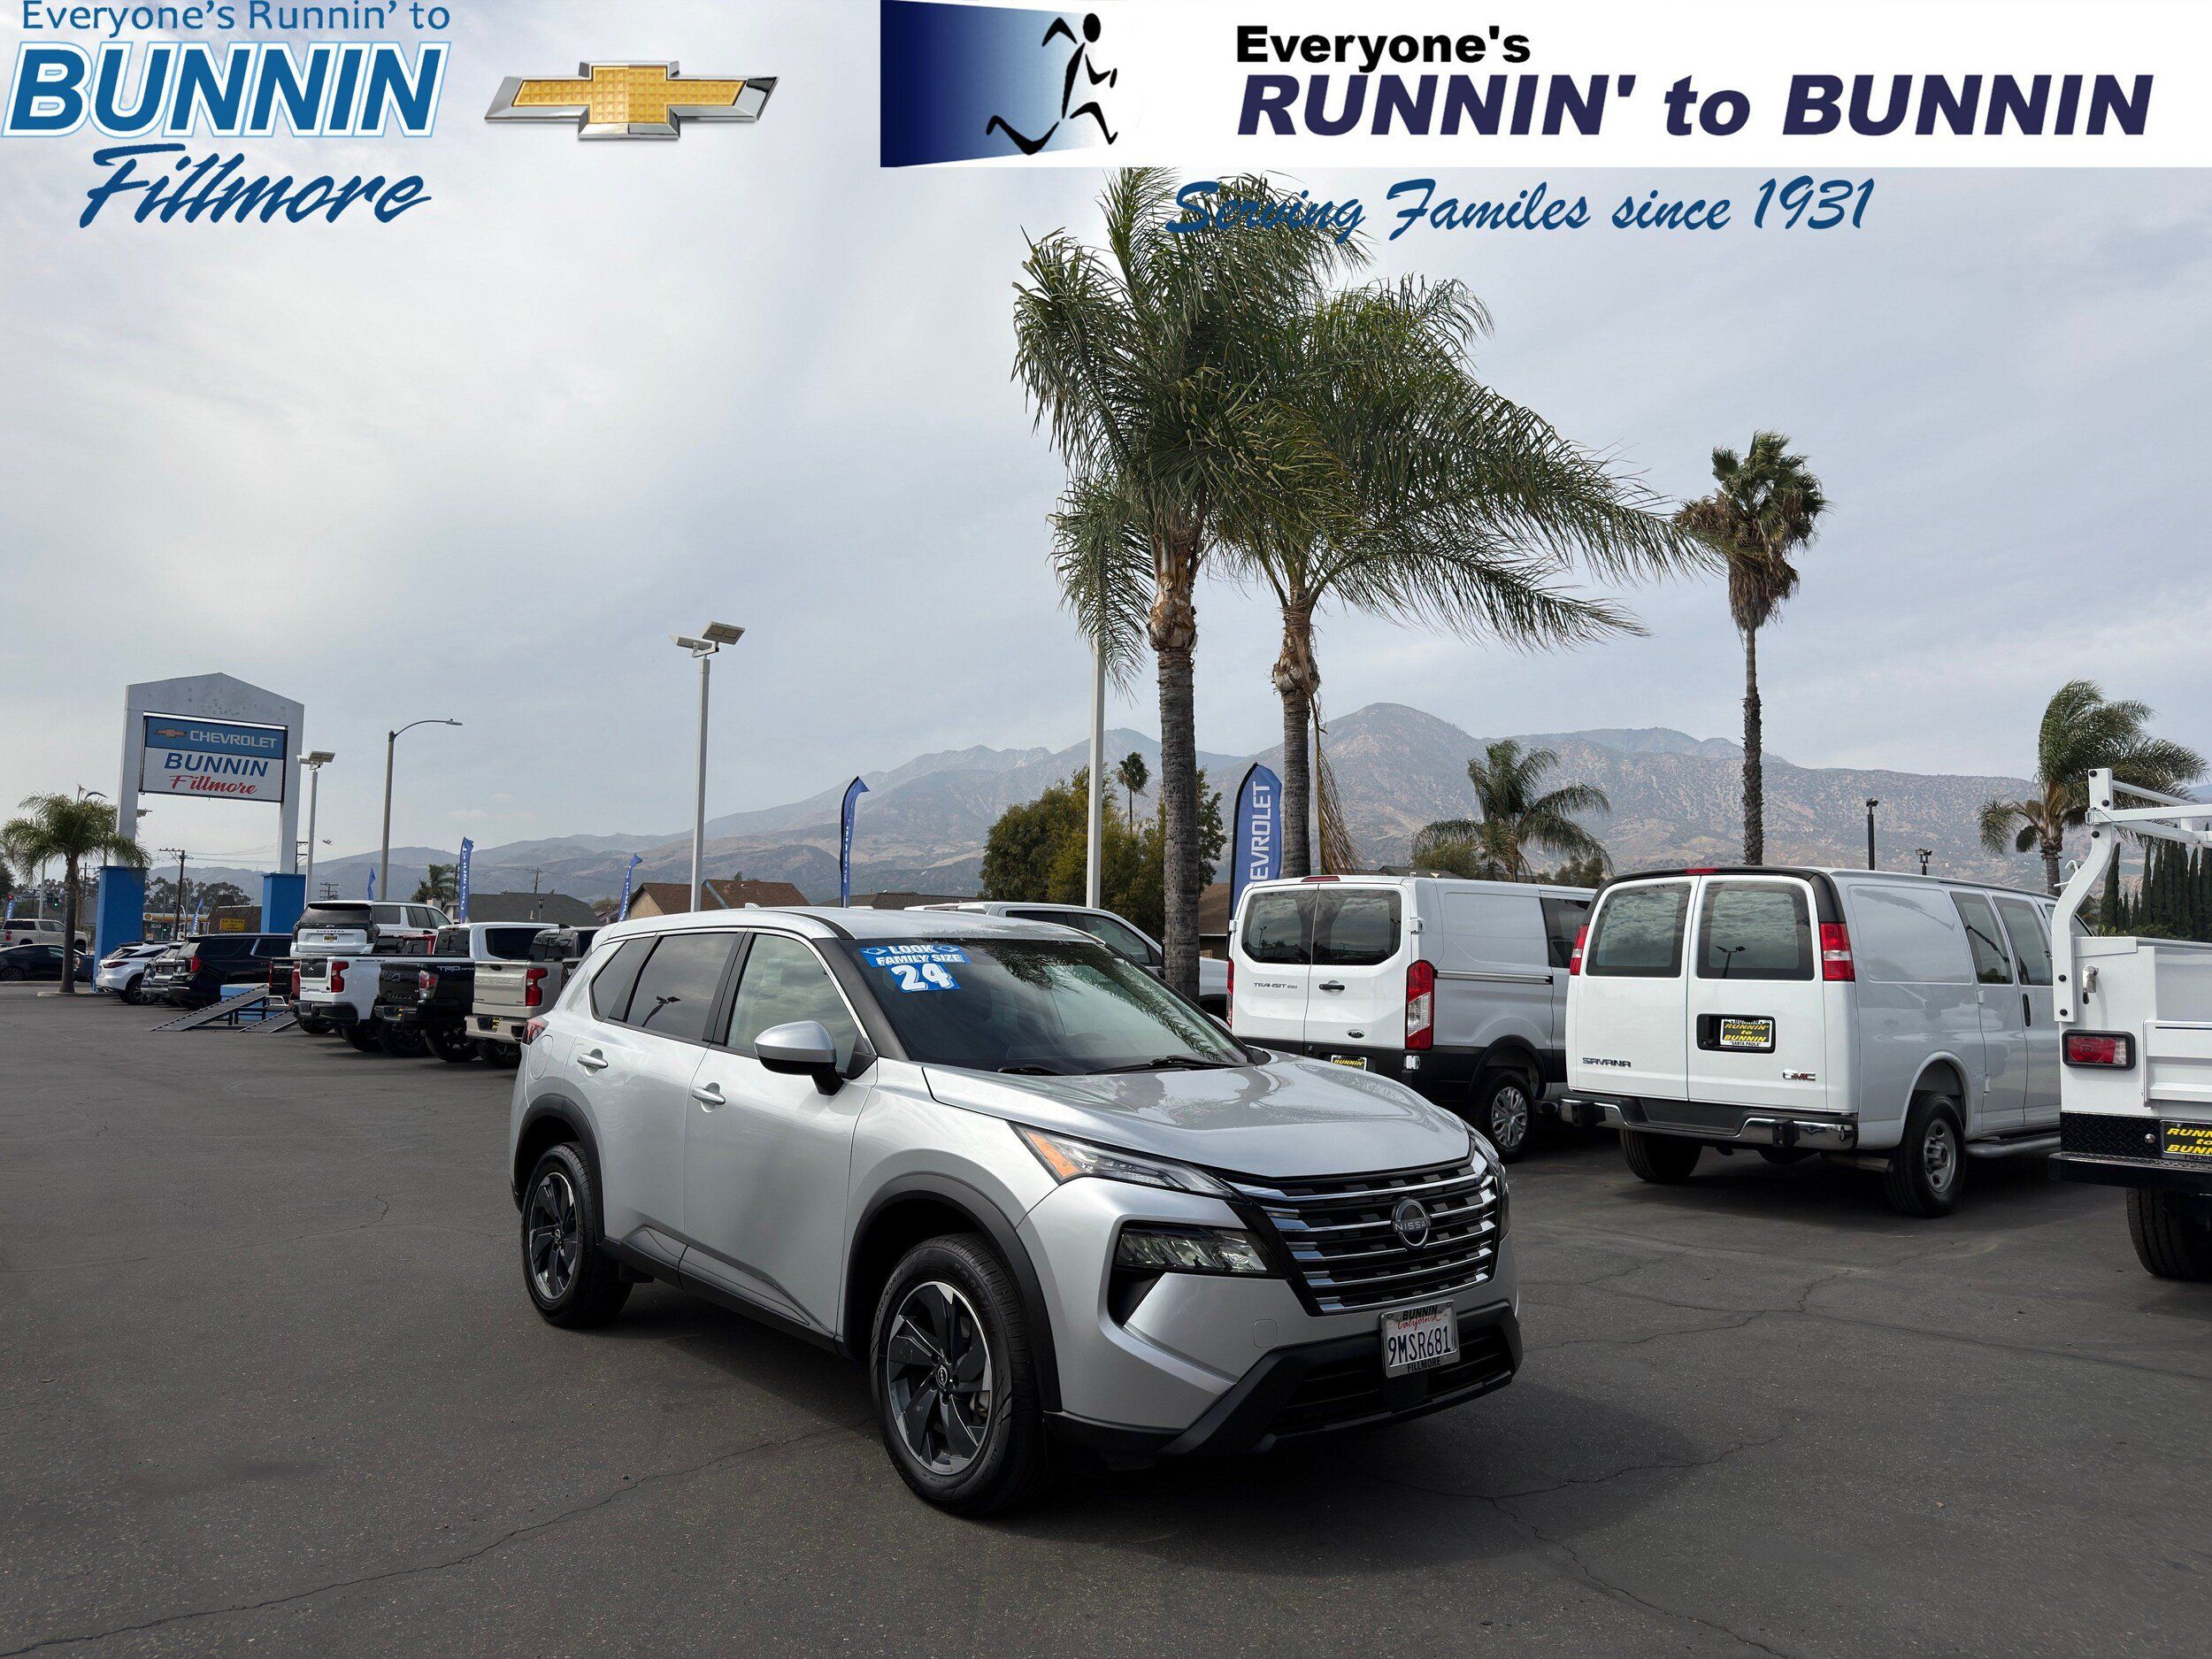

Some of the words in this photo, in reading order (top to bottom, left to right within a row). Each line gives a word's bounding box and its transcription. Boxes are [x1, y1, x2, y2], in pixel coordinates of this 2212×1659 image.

[189, 730, 278, 749] CHEVROLET
[164, 752, 269, 778] BUNNIN
[169, 774, 258, 795] Fillmore
[1249, 780, 1271, 884] EVROLET
[887, 944, 939, 955] LOOK
[876, 954, 929, 966] FAMILY
[891, 963, 955, 991] 24
[1582, 1057, 1631, 1068] SAVANA
[1782, 1069, 1816, 1081] GMC
[1394, 1218, 1432, 1232] NISSAN
[1402, 1304, 1439, 1321] BUNNIN
[1397, 1314, 1441, 1331] California
[1387, 1325, 1451, 1366] 9MSR681
[1407, 1356, 1441, 1372] FILLMORE
